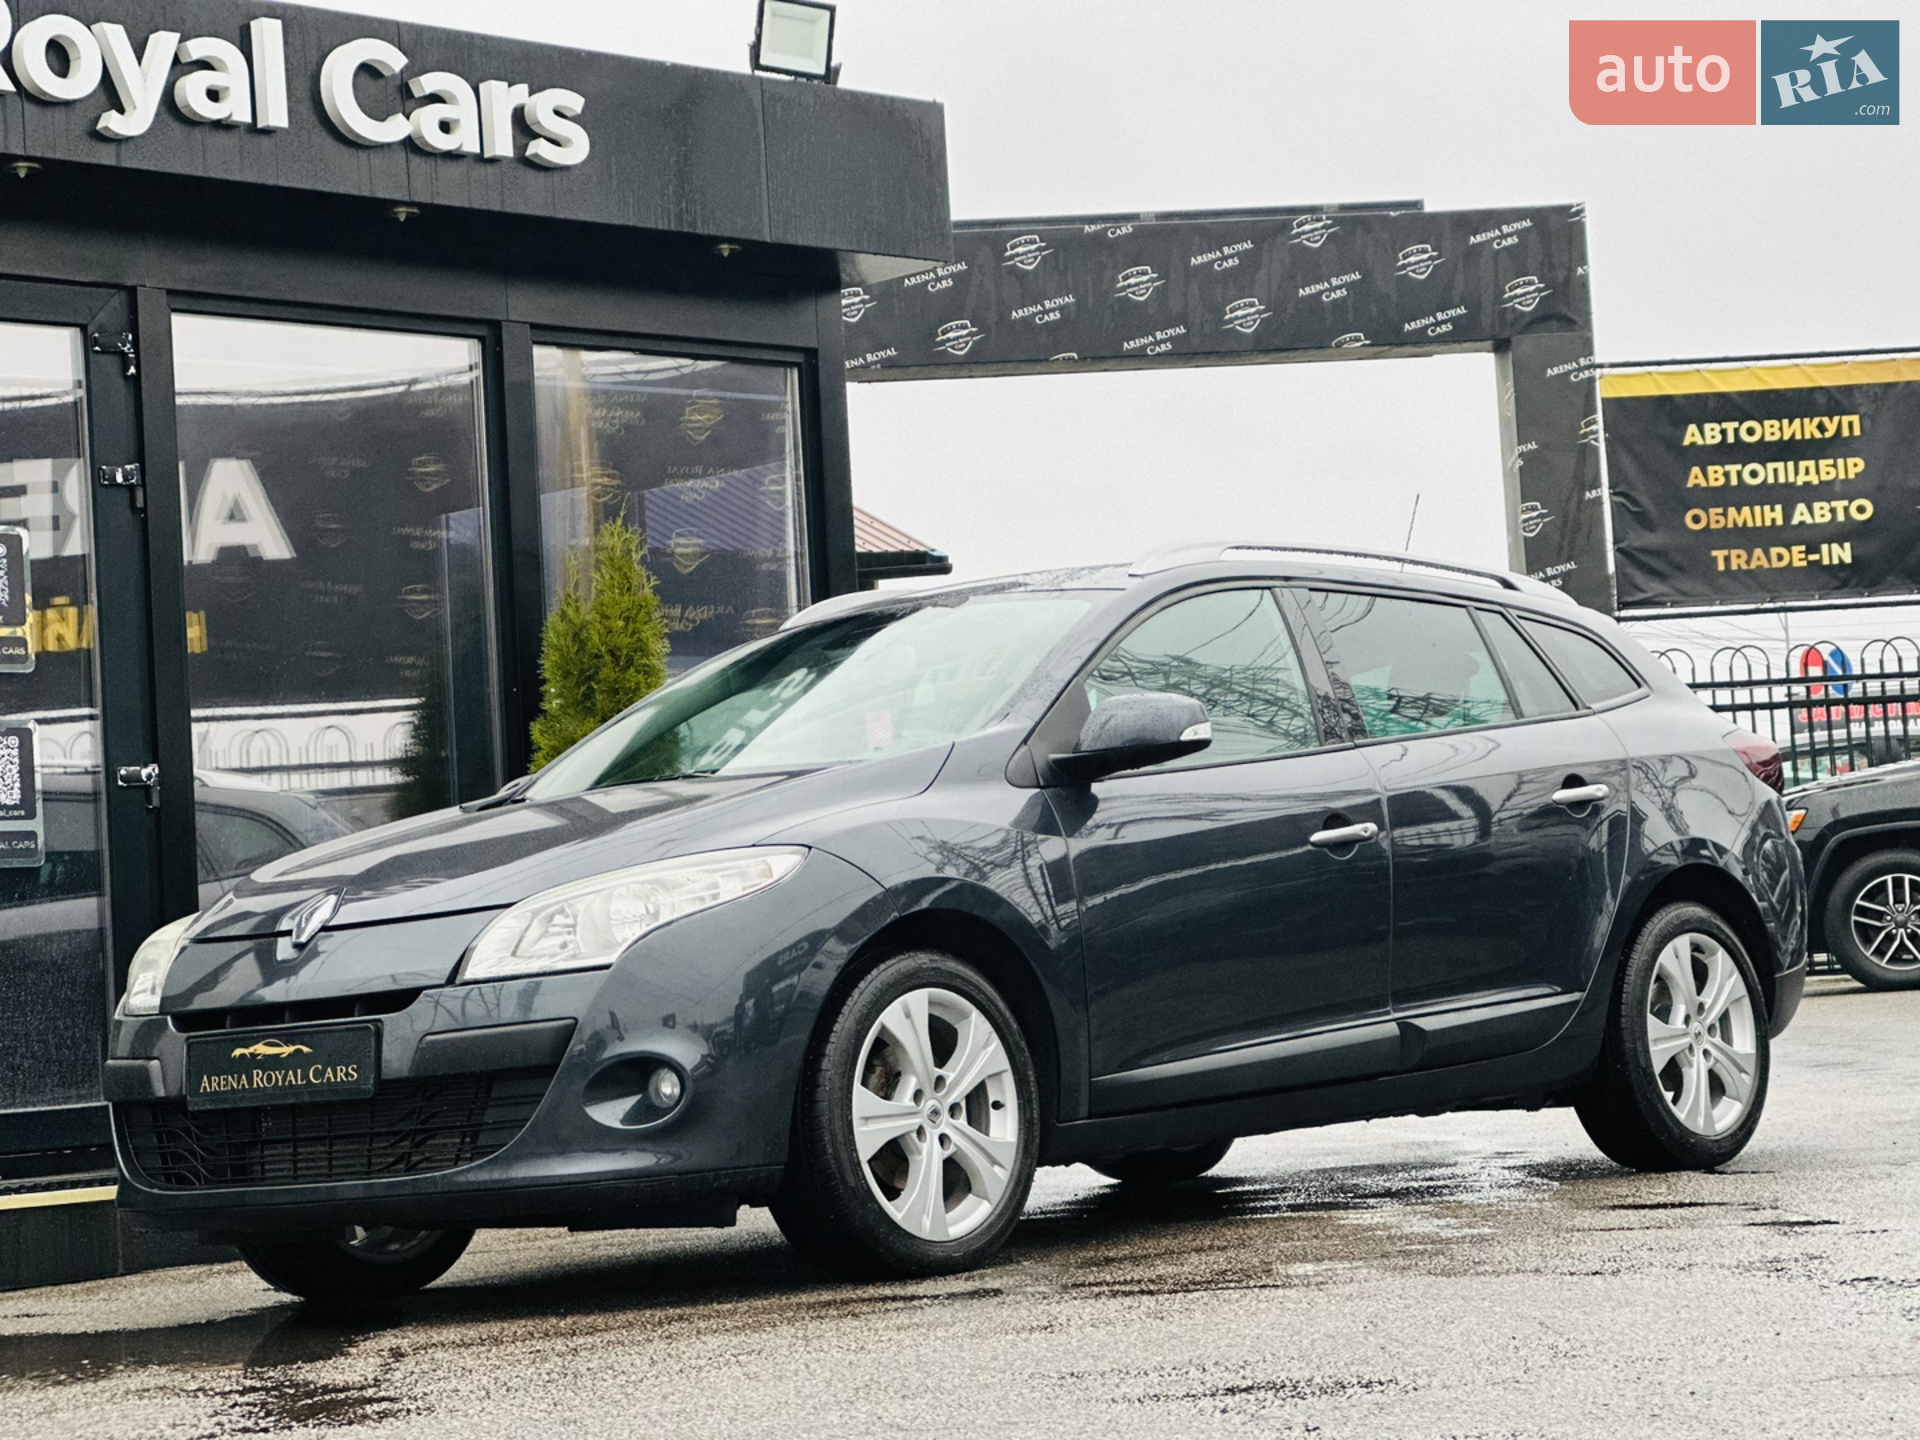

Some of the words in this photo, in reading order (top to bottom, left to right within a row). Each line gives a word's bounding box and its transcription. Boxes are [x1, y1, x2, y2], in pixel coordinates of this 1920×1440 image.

[319, 37, 591, 168] Cars
[1469, 229, 1500, 246] ARENA
[1501, 218, 1533, 236] ROYAL
[1493, 234, 1519, 249] CARS
[1190, 250, 1222, 267] ARENA
[1222, 239, 1254, 258] ROYAL
[1213, 256, 1239, 271] CARS
[903, 270, 936, 287] ARENA
[936, 260, 968, 278] ROYAL
[927, 277, 953, 292] CARS
[1298, 280, 1330, 298] ARENA
[1330, 271, 1362, 288] ROYAL
[1010, 303, 1042, 320] ARENA
[1043, 294, 1076, 311] ROYAL
[1321, 287, 1348, 302] CARS
[1035, 310, 1061, 325] CARS
[1402, 315, 1434, 333] ARENA
[1435, 305, 1468, 323] ROYAL
[1427, 321, 1453, 337] CARS
[1122, 335, 1154, 351] ARENA
[1155, 325, 1188, 342] ROYAL
[1146, 340, 1173, 356] CARS
[866, 346, 898, 363] ROYAL
[1545, 360, 1578, 379] ARENA
[1682, 414, 1861, 446] АВТОВИКУП
[1686, 456, 1866, 488] АВТОПІДБІР
[1684, 503, 1784, 531] ОБМІН
[1790, 497, 1875, 526] АВТО
[1711, 541, 1853, 572] TRADE-IN
[199, 1073, 249, 1093] ARENA
[252, 1067, 306, 1089] ROYAL
[308, 1064, 358, 1084] CARS
